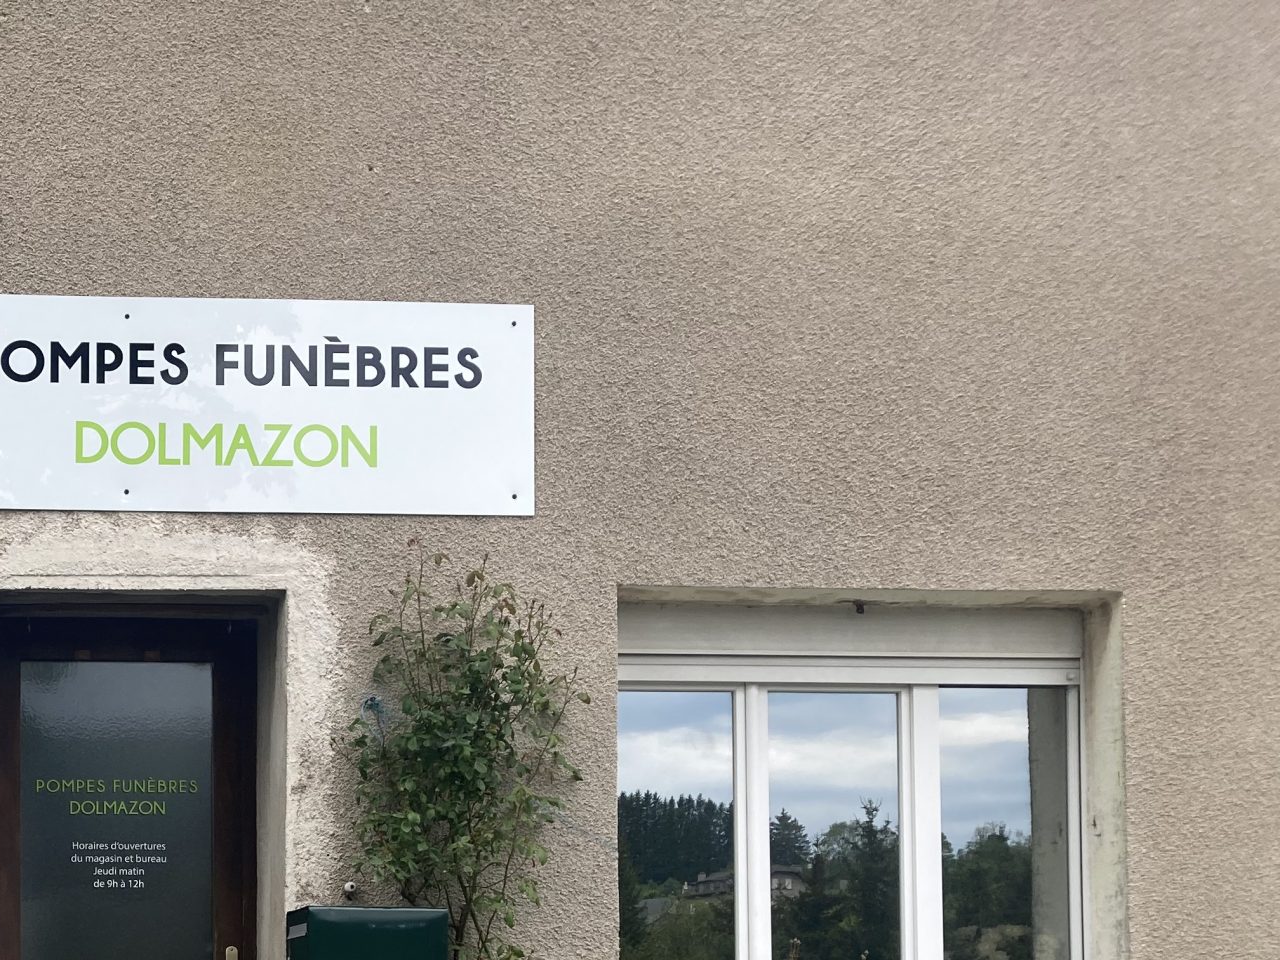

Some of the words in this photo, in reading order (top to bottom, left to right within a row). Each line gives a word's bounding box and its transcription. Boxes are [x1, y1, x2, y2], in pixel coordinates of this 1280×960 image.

[215, 336, 483, 390] FUNÈBRES
[74, 419, 378, 468] DOLMAZON
[36, 779, 105, 793] POMPES
[113, 777, 198, 793] FUNÈBRES
[70, 801, 166, 815] DOLMAZON
[72, 842, 109, 850] Horaires
[110, 842, 166, 851] d'ouvertures
[71, 854, 83, 863] du
[85, 854, 122, 864] magasin
[124, 855, 133, 863] et
[135, 855, 167, 863] bureau
[93, 867, 117, 875] Jeudi
[119, 867, 145, 875] matin
[93, 879, 105, 888] de
[106, 879, 118, 888] 9h
[120, 880, 126, 888] à
[128, 879, 145, 888] 12h
